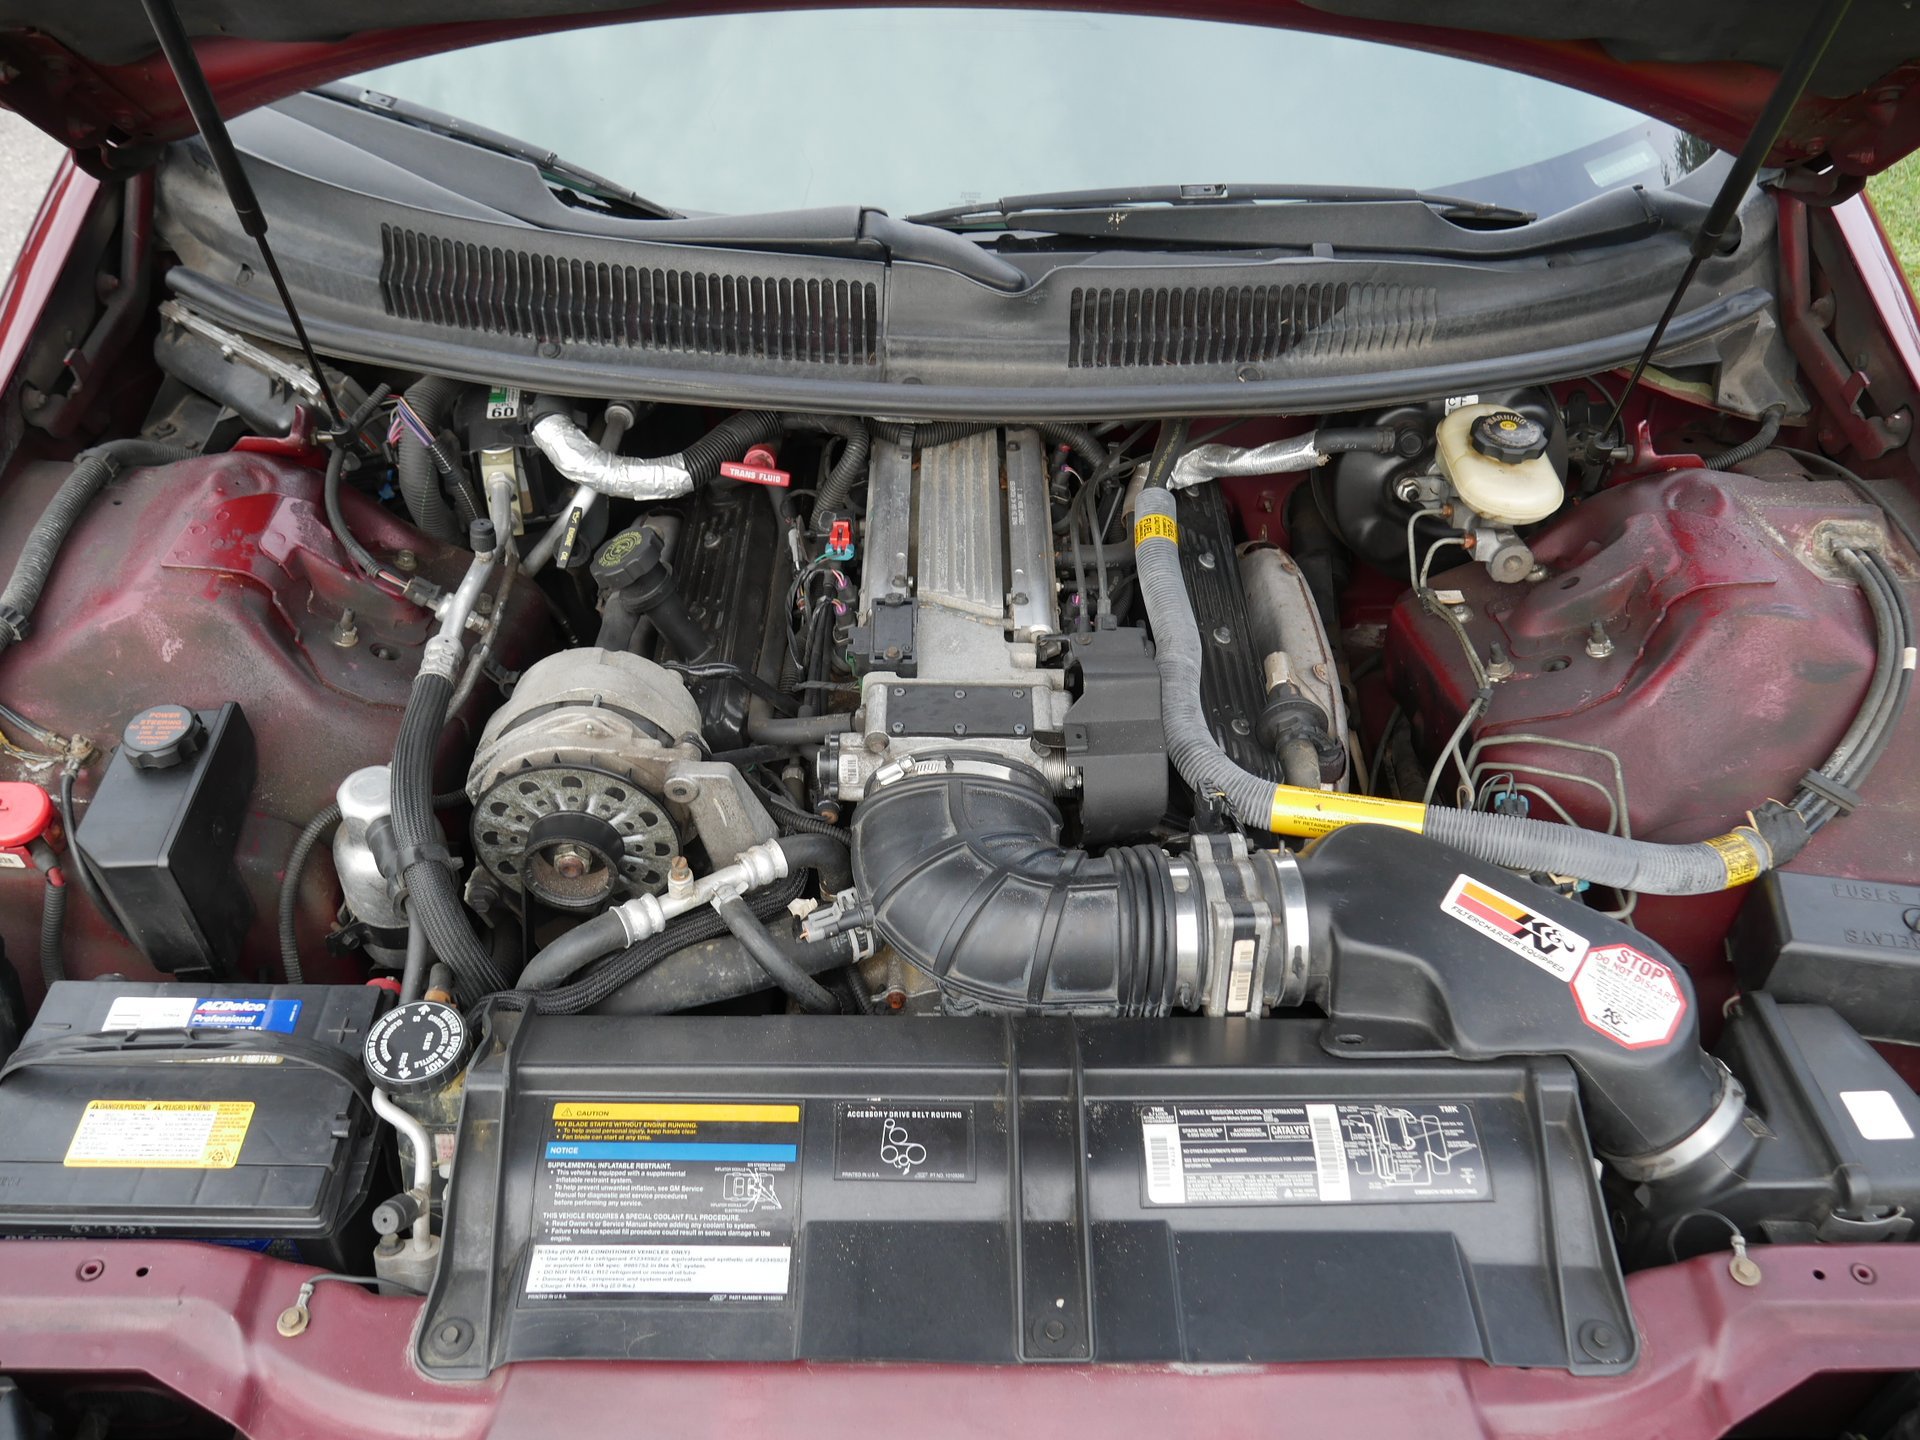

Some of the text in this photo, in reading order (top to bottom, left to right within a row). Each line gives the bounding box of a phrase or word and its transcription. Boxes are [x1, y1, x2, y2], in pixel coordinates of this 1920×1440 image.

[491, 407, 514, 417] 60
[1484, 414, 1527, 425] WARNING
[729, 467, 781, 483] TRANS FLUID
[564, 526, 576, 547] ENGINE
[1302, 821, 1332, 829] RETAINER
[1451, 906, 1565, 973] FILTERCHARGER EQUIPPED
[1617, 949, 1664, 980] STOP
[1595, 953, 1678, 1003] DO NOT DISCARD
[197, 1001, 267, 1012] ACDelco
[192, 1014, 256, 1024] Professional
[440, 1009, 461, 1035] NEVER
[442, 1035, 460, 1060] OPEN
[424, 1058, 445, 1076] HOT
[931, 1111, 962, 1119] ROUTING
[1270, 1125, 1310, 1135] CATALYST
[550, 1146, 579, 1154] NOTICE
